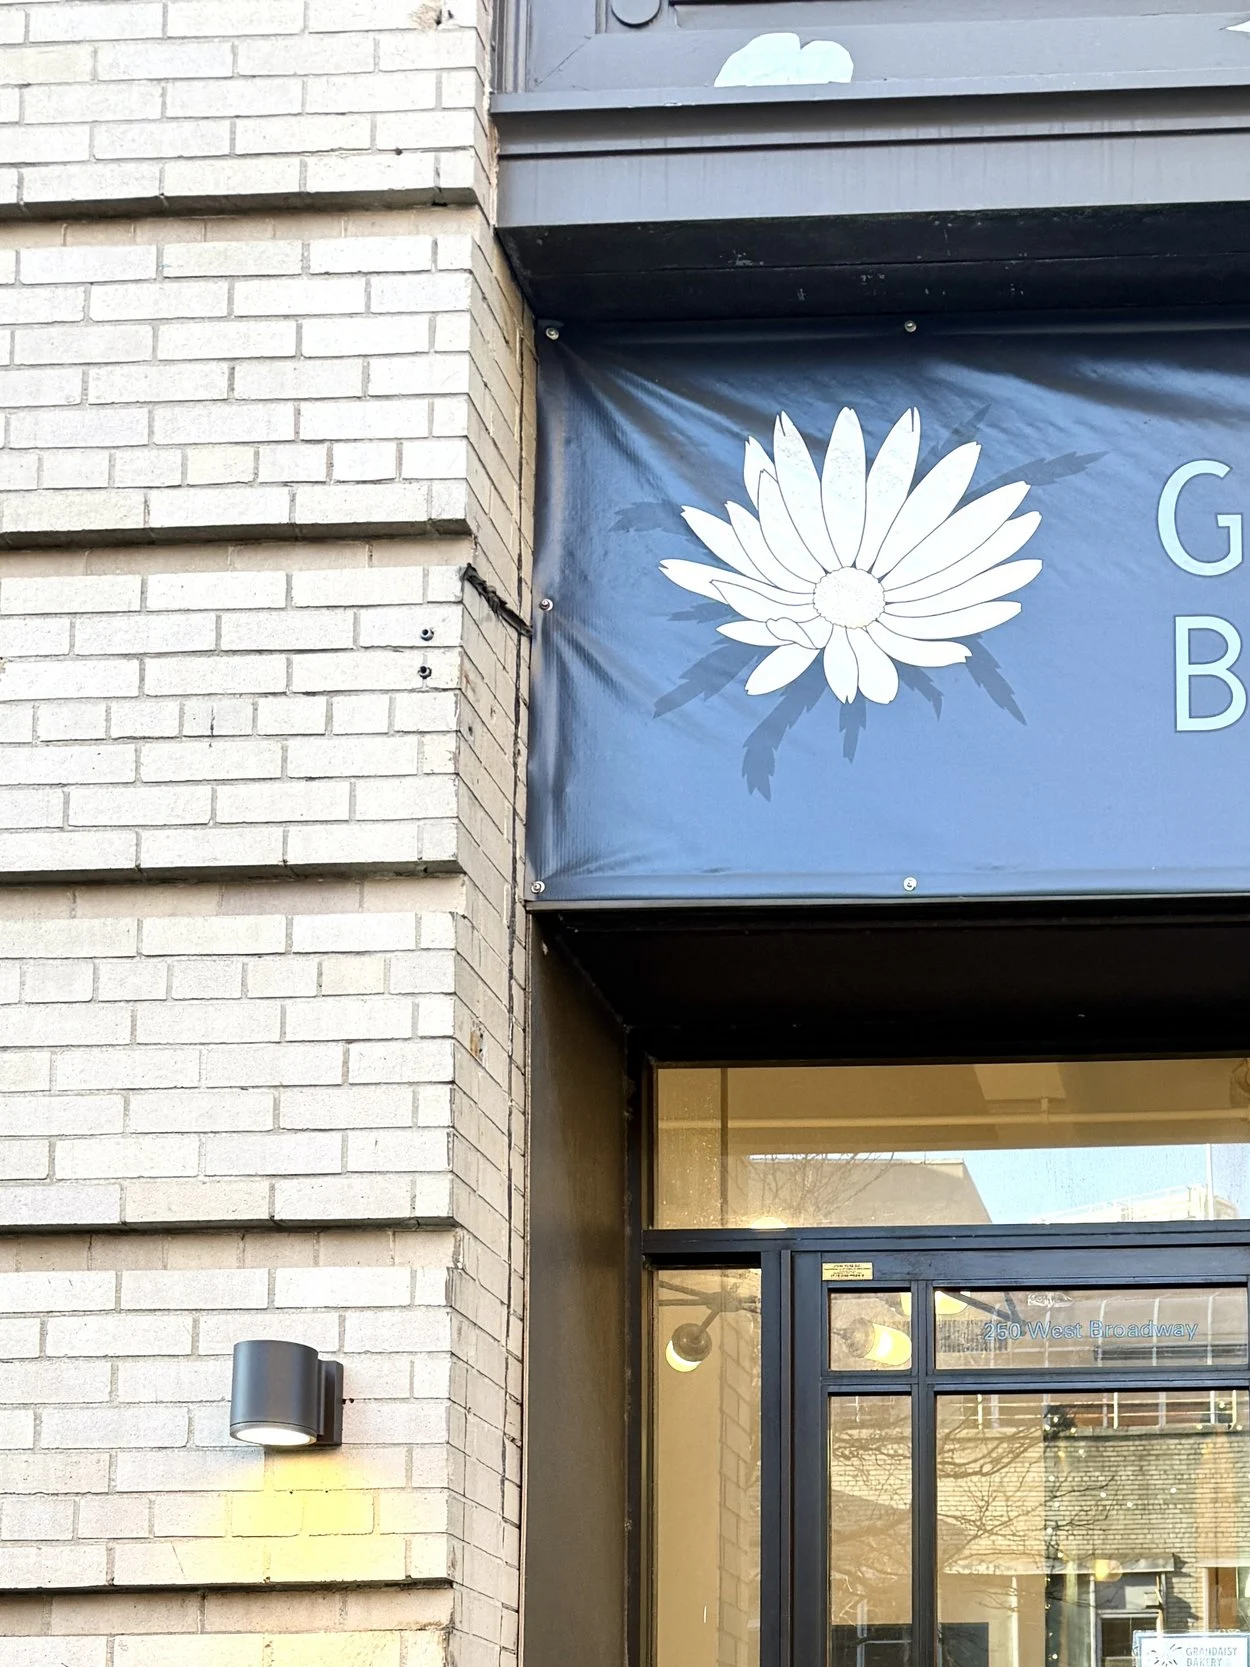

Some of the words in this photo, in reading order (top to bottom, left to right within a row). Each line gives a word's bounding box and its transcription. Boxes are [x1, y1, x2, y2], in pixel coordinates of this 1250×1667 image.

[984, 1322, 1021, 1340] 250
[1027, 1320, 1083, 1339] West
[1089, 1319, 1198, 1340] Broadway
[1185, 1647, 1238, 1656] GRANDAISY
[1186, 1658, 1223, 1667] BAKERY
